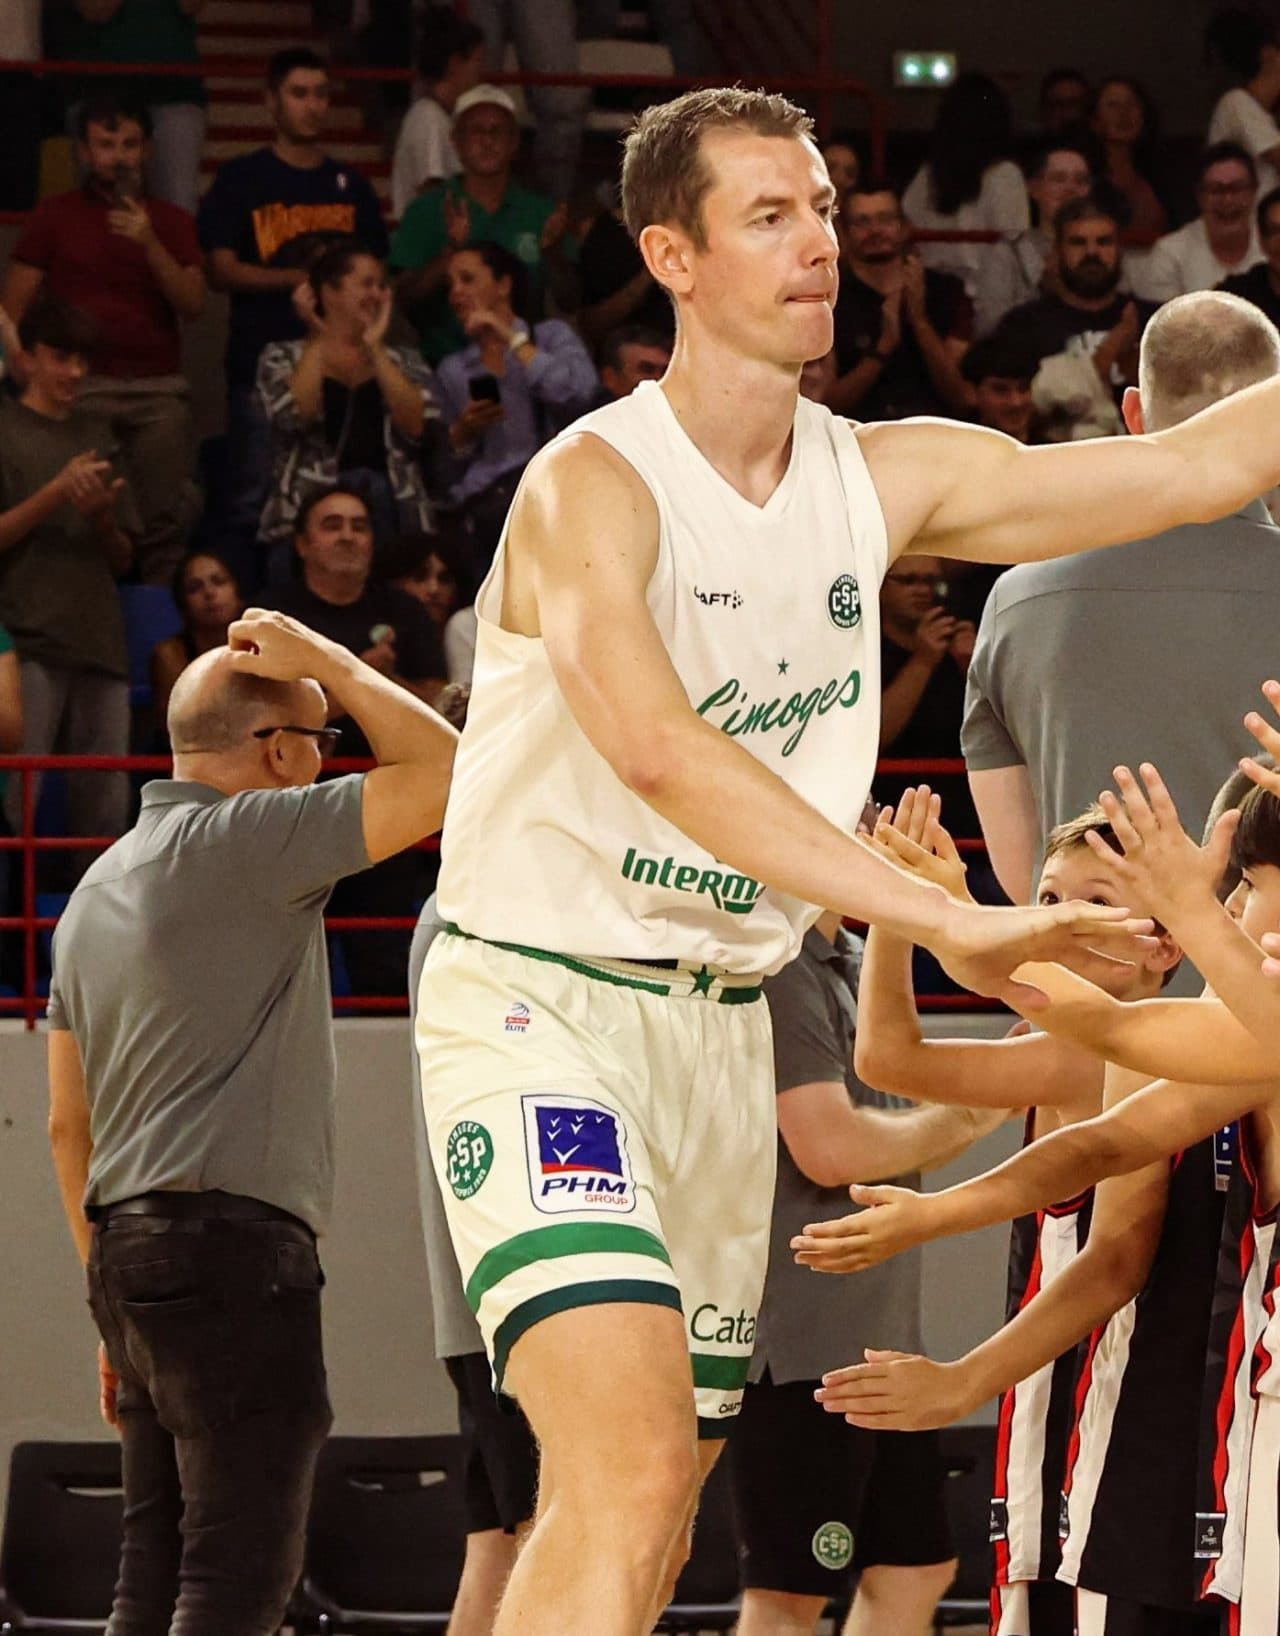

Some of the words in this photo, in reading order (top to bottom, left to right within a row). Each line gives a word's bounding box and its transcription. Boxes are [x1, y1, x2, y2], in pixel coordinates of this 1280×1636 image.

[832, 584, 860, 611] CSP
[697, 669, 861, 757] Limoges
[621, 848, 766, 914] Interm
[449, 1136, 486, 1184] CSP
[541, 1176, 627, 1197] PHM
[584, 1193, 628, 1205] GROUP
[819, 1532, 849, 1555] CSP
